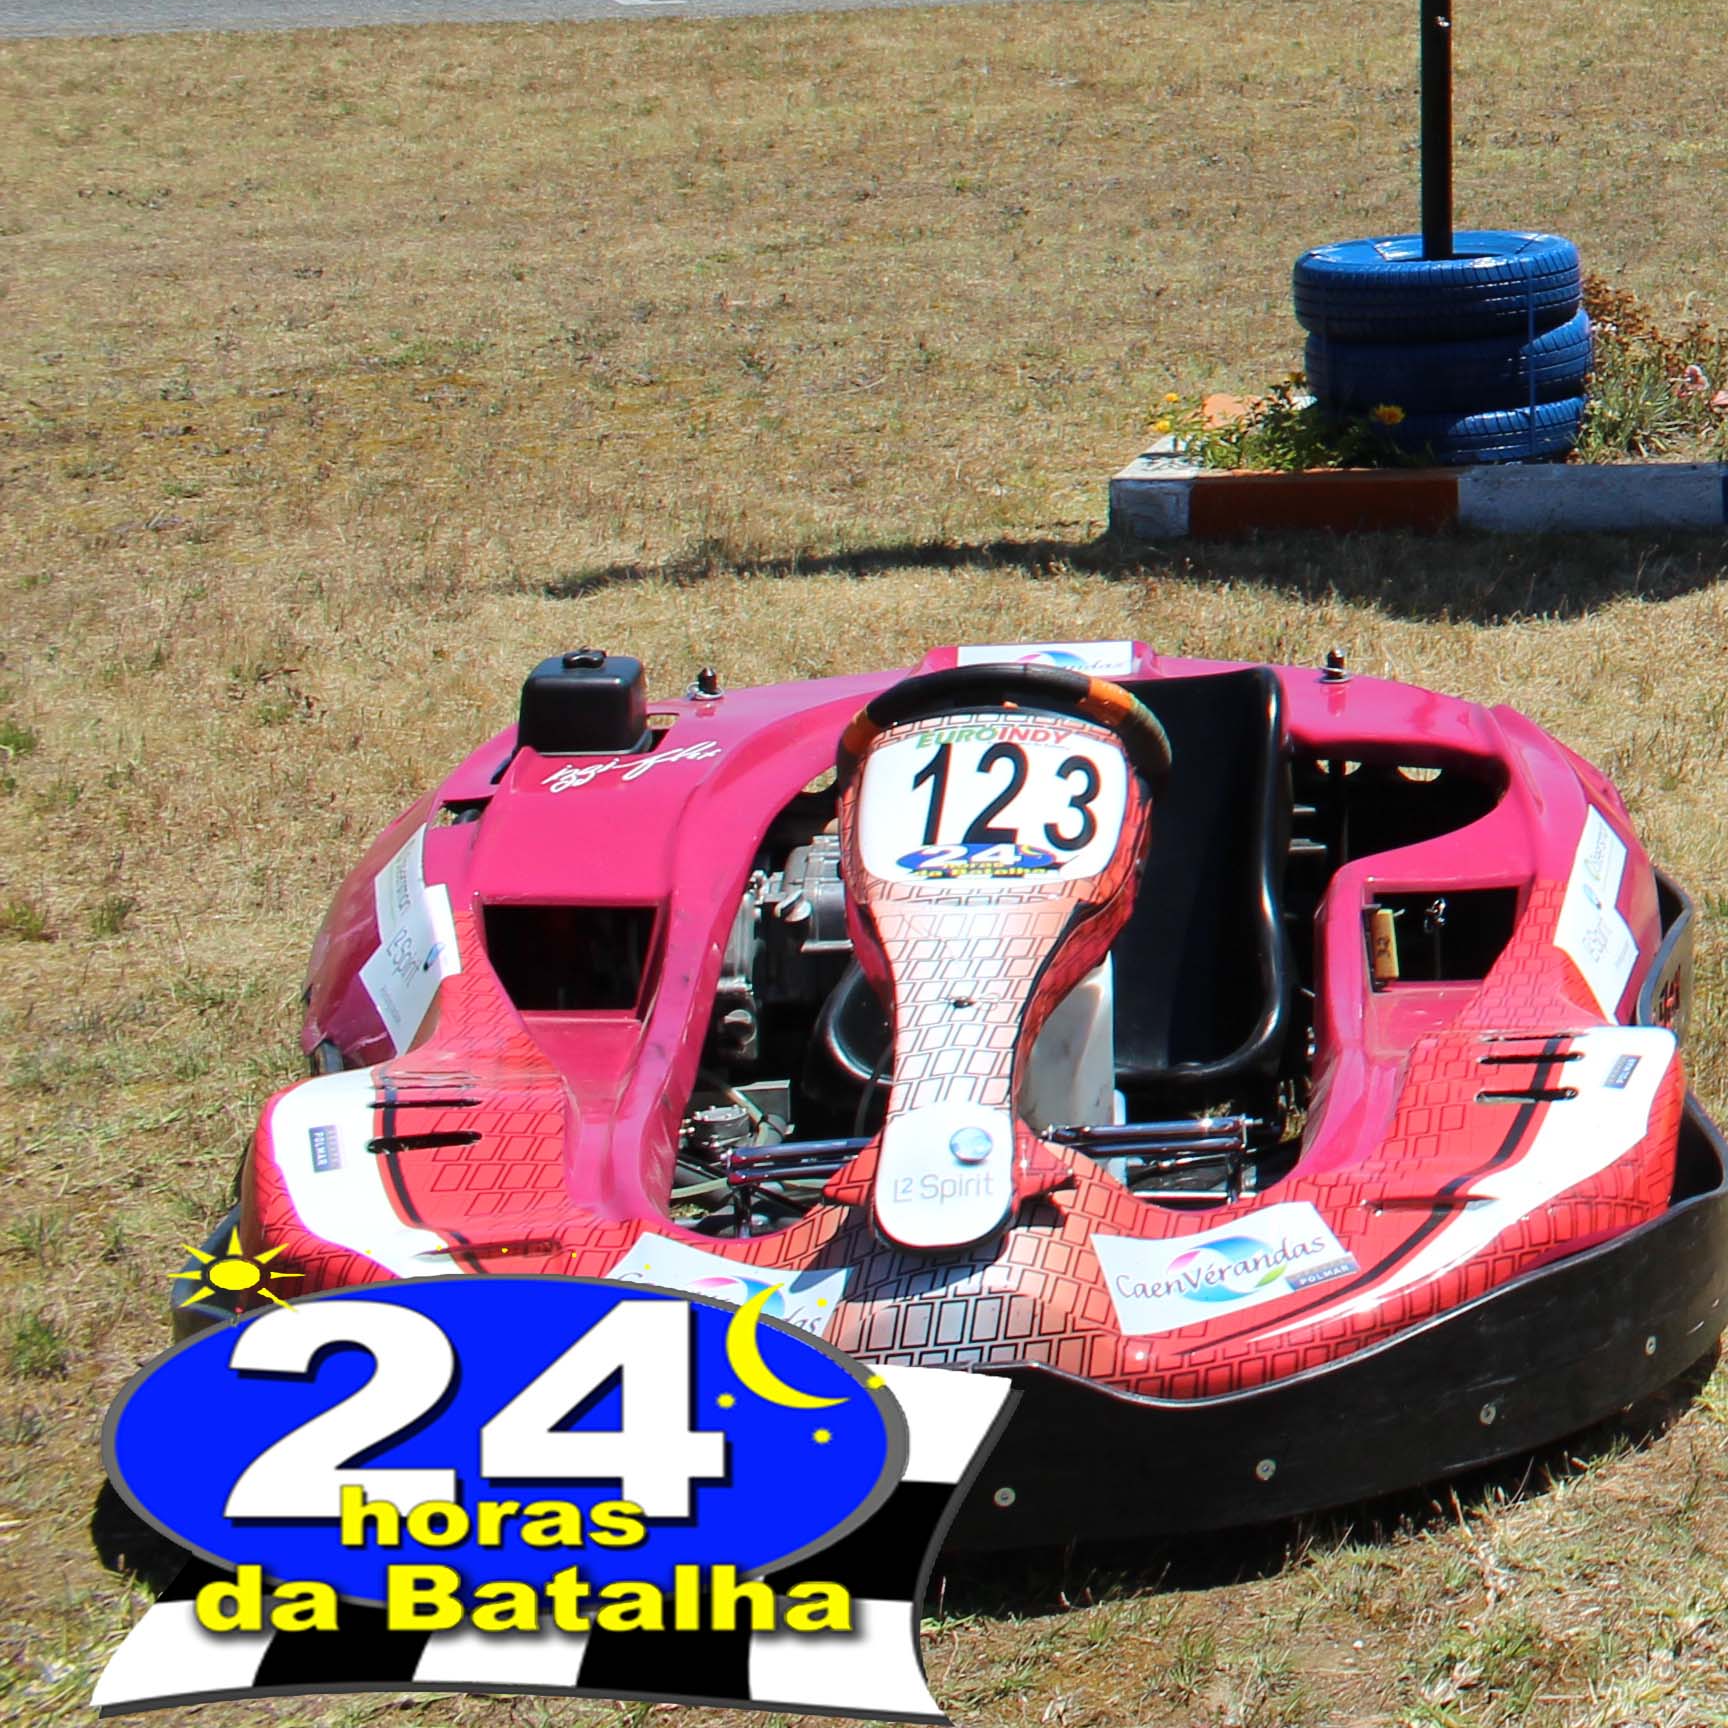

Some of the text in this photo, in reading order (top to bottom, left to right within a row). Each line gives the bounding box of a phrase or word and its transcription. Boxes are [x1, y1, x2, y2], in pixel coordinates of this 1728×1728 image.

[915, 725, 1073, 751] EUROINDY
[911, 742, 1101, 852] 123
[919, 1172, 994, 1205] Spirit
[1299, 1263, 1351, 1287] POLMAR
